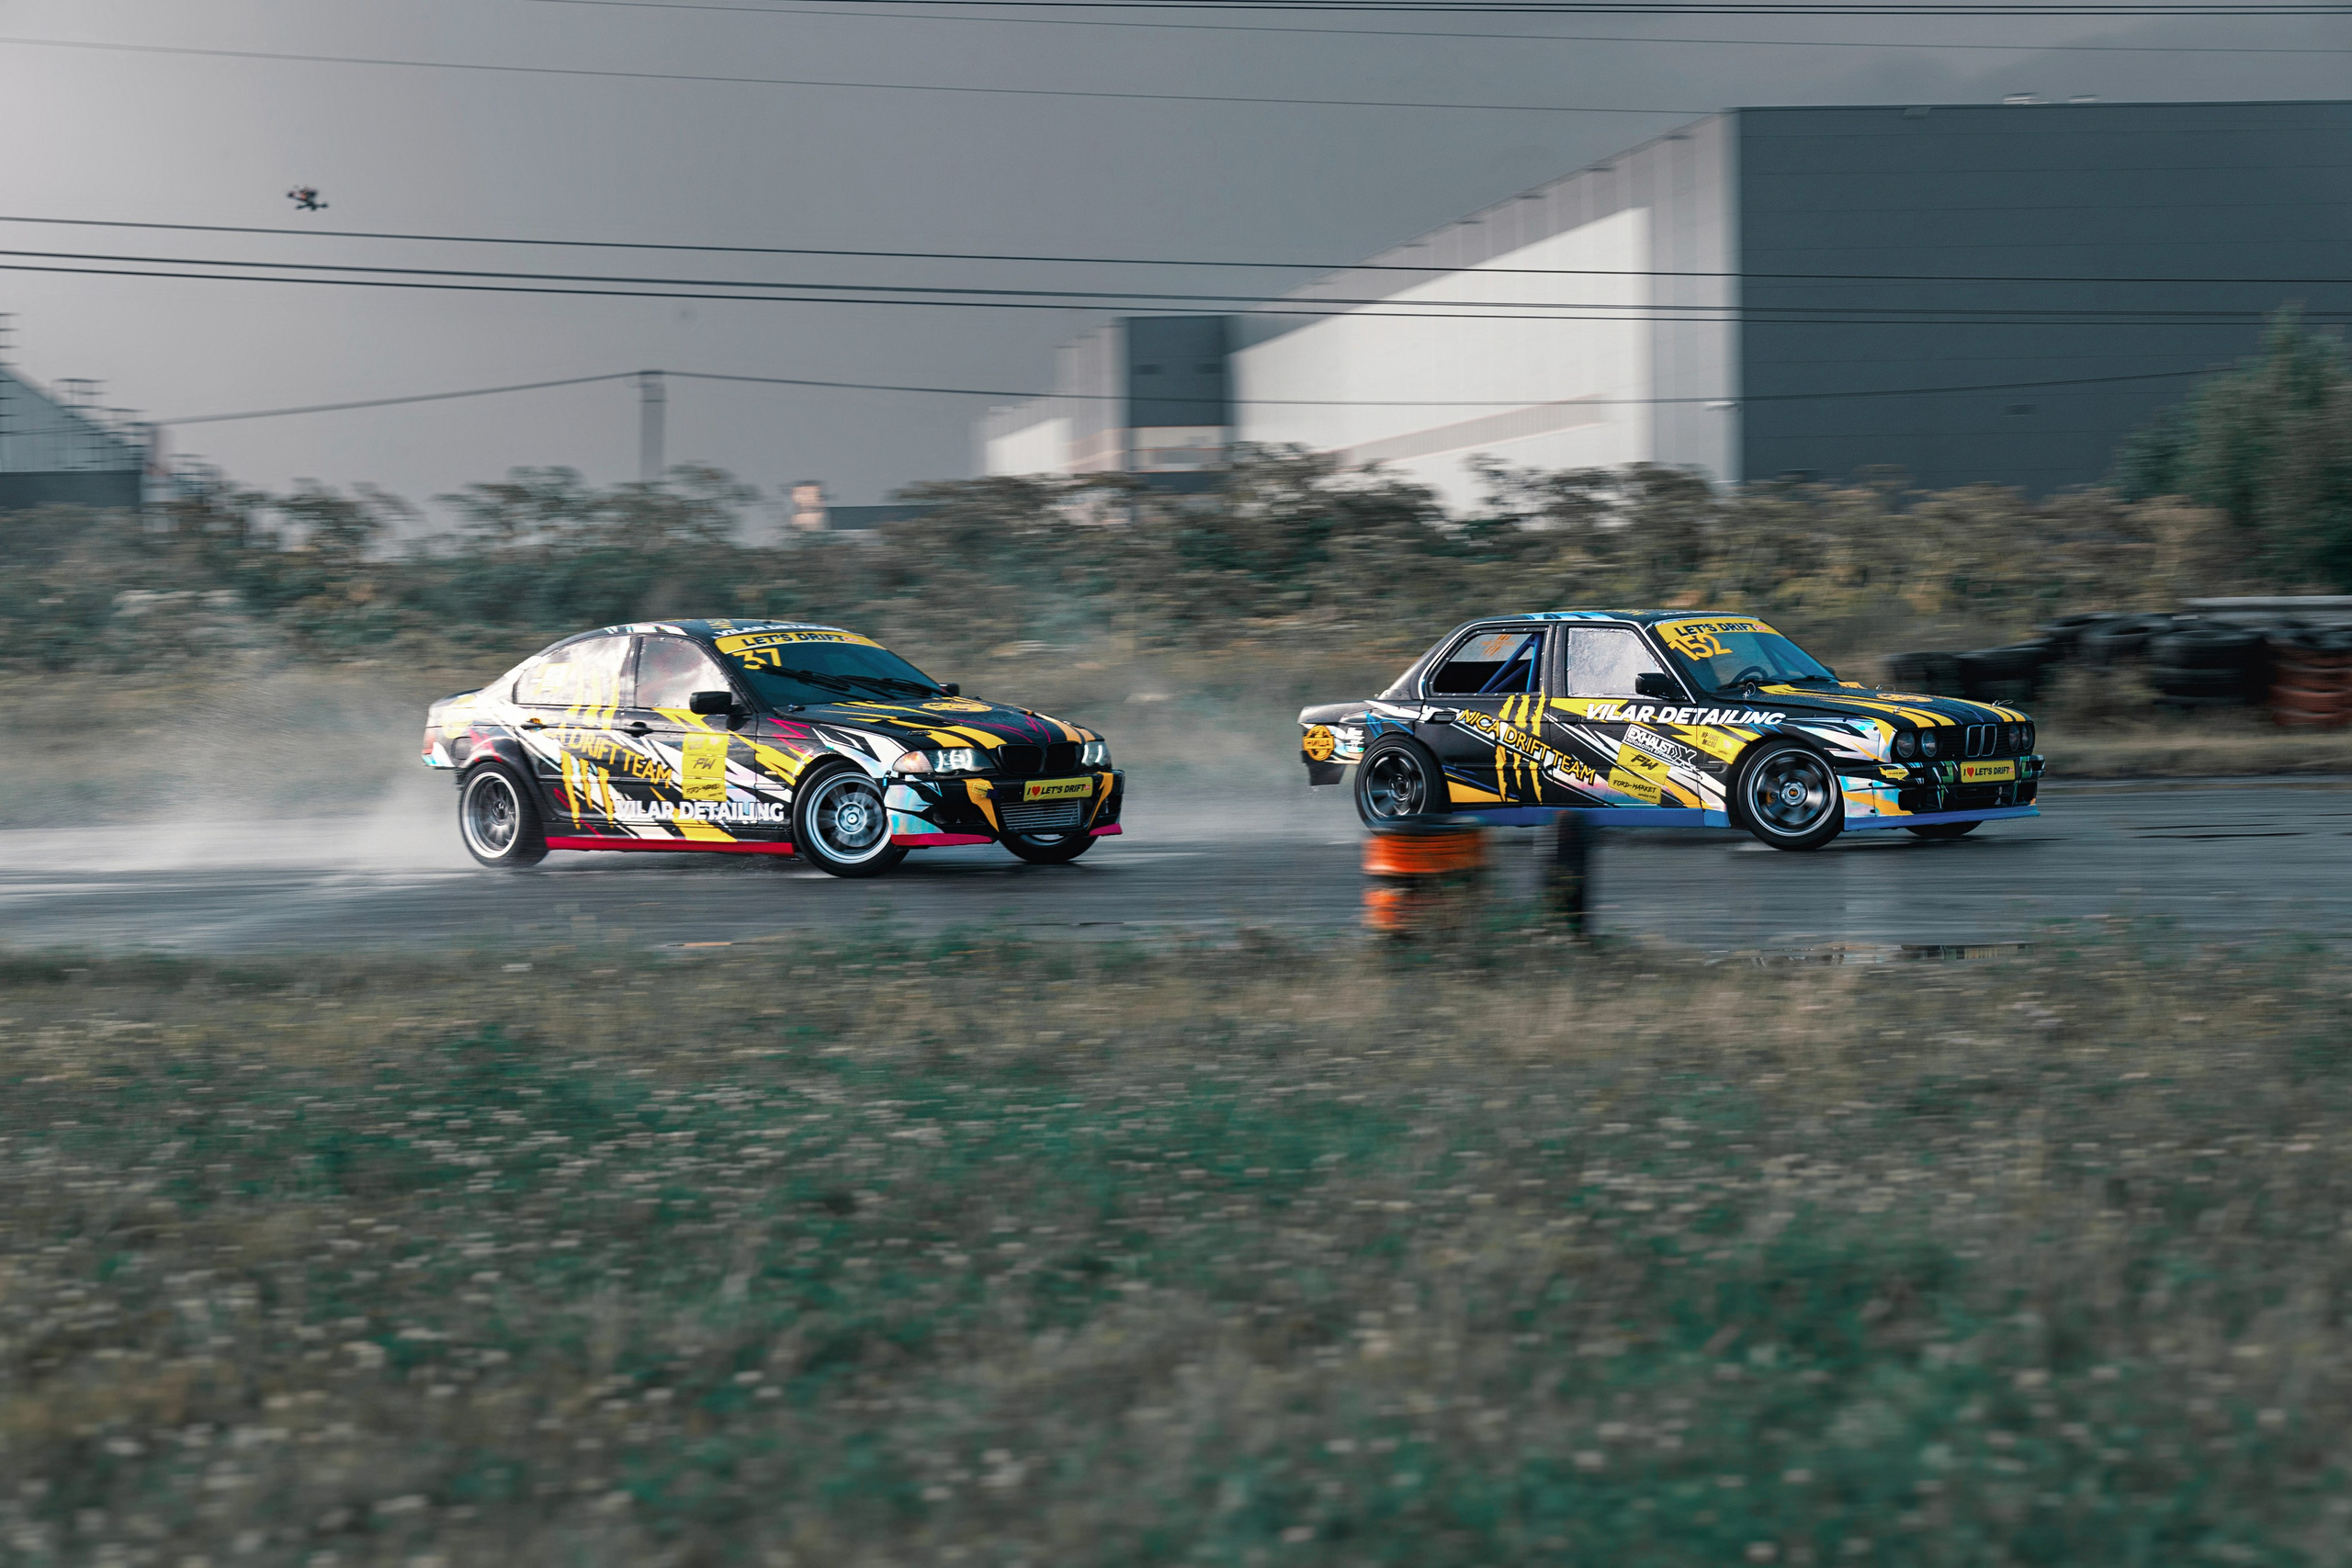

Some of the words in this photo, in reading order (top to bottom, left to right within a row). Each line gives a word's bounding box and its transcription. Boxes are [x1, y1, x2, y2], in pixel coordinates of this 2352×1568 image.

[1673, 622, 1717, 637] LET'S
[1716, 623, 1758, 633] DRIFT
[741, 633, 794, 647] LET'S
[798, 633, 845, 643] DRIFT
[1668, 634, 1733, 661] 152
[731, 648, 783, 671] 37
[1586, 704, 1655, 723] VILAR
[1657, 706, 1787, 726] DETAILING
[1459, 708, 1500, 738] NICA
[1503, 726, 1551, 761] DRIFT
[1553, 749, 1597, 785] TEAM
[1627, 727, 1676, 756] EXHAUST
[569, 727, 622, 764] DRIFT
[622, 748, 673, 789] TEAM
[692, 758, 717, 770] PW
[1630, 753, 1660, 771] PW
[1975, 767, 1993, 776] LET'S
[1993, 766, 2009, 775] DRIFT
[1026, 787, 1031, 795] I
[1040, 785, 1063, 795] LET'S
[1065, 784, 1085, 793] DRIFT
[1613, 780, 1657, 794] FORD-MARKET
[615, 800, 675, 820] VILAR
[679, 801, 785, 822] DETAILING
